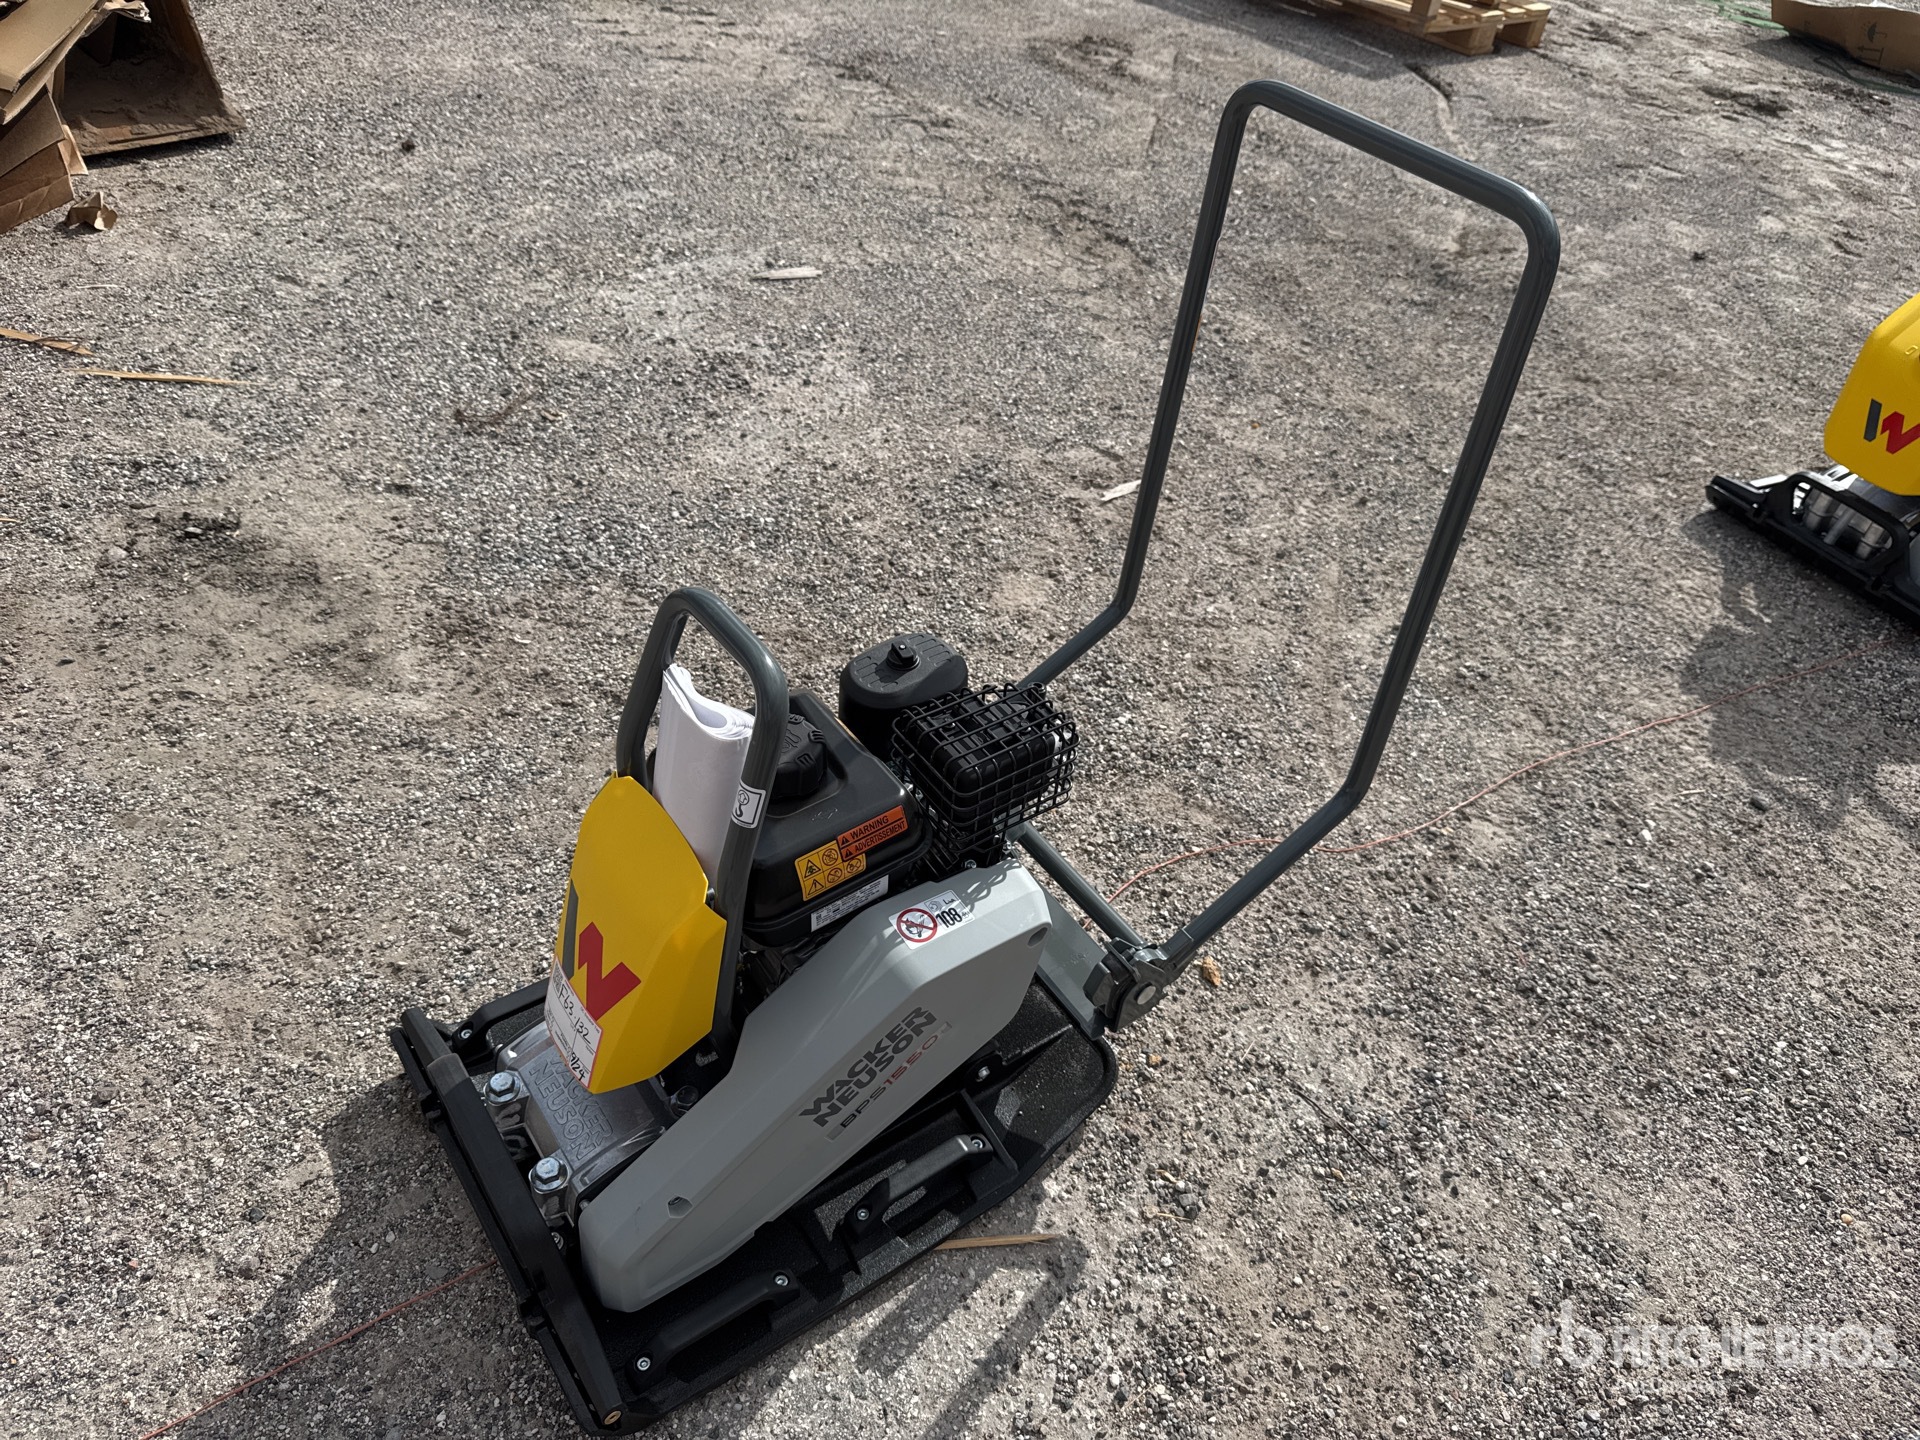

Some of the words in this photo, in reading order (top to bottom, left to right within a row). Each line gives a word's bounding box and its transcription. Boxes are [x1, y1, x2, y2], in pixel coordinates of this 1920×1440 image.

[850, 815, 889, 840] WARNING
[855, 821, 906, 852] ADVERTISSEMENT
[936, 907, 963, 928] 108
[799, 1006, 929, 1117] WACKER
[813, 1012, 937, 1127] NEUSON
[529, 1060, 597, 1160] NEUSON
